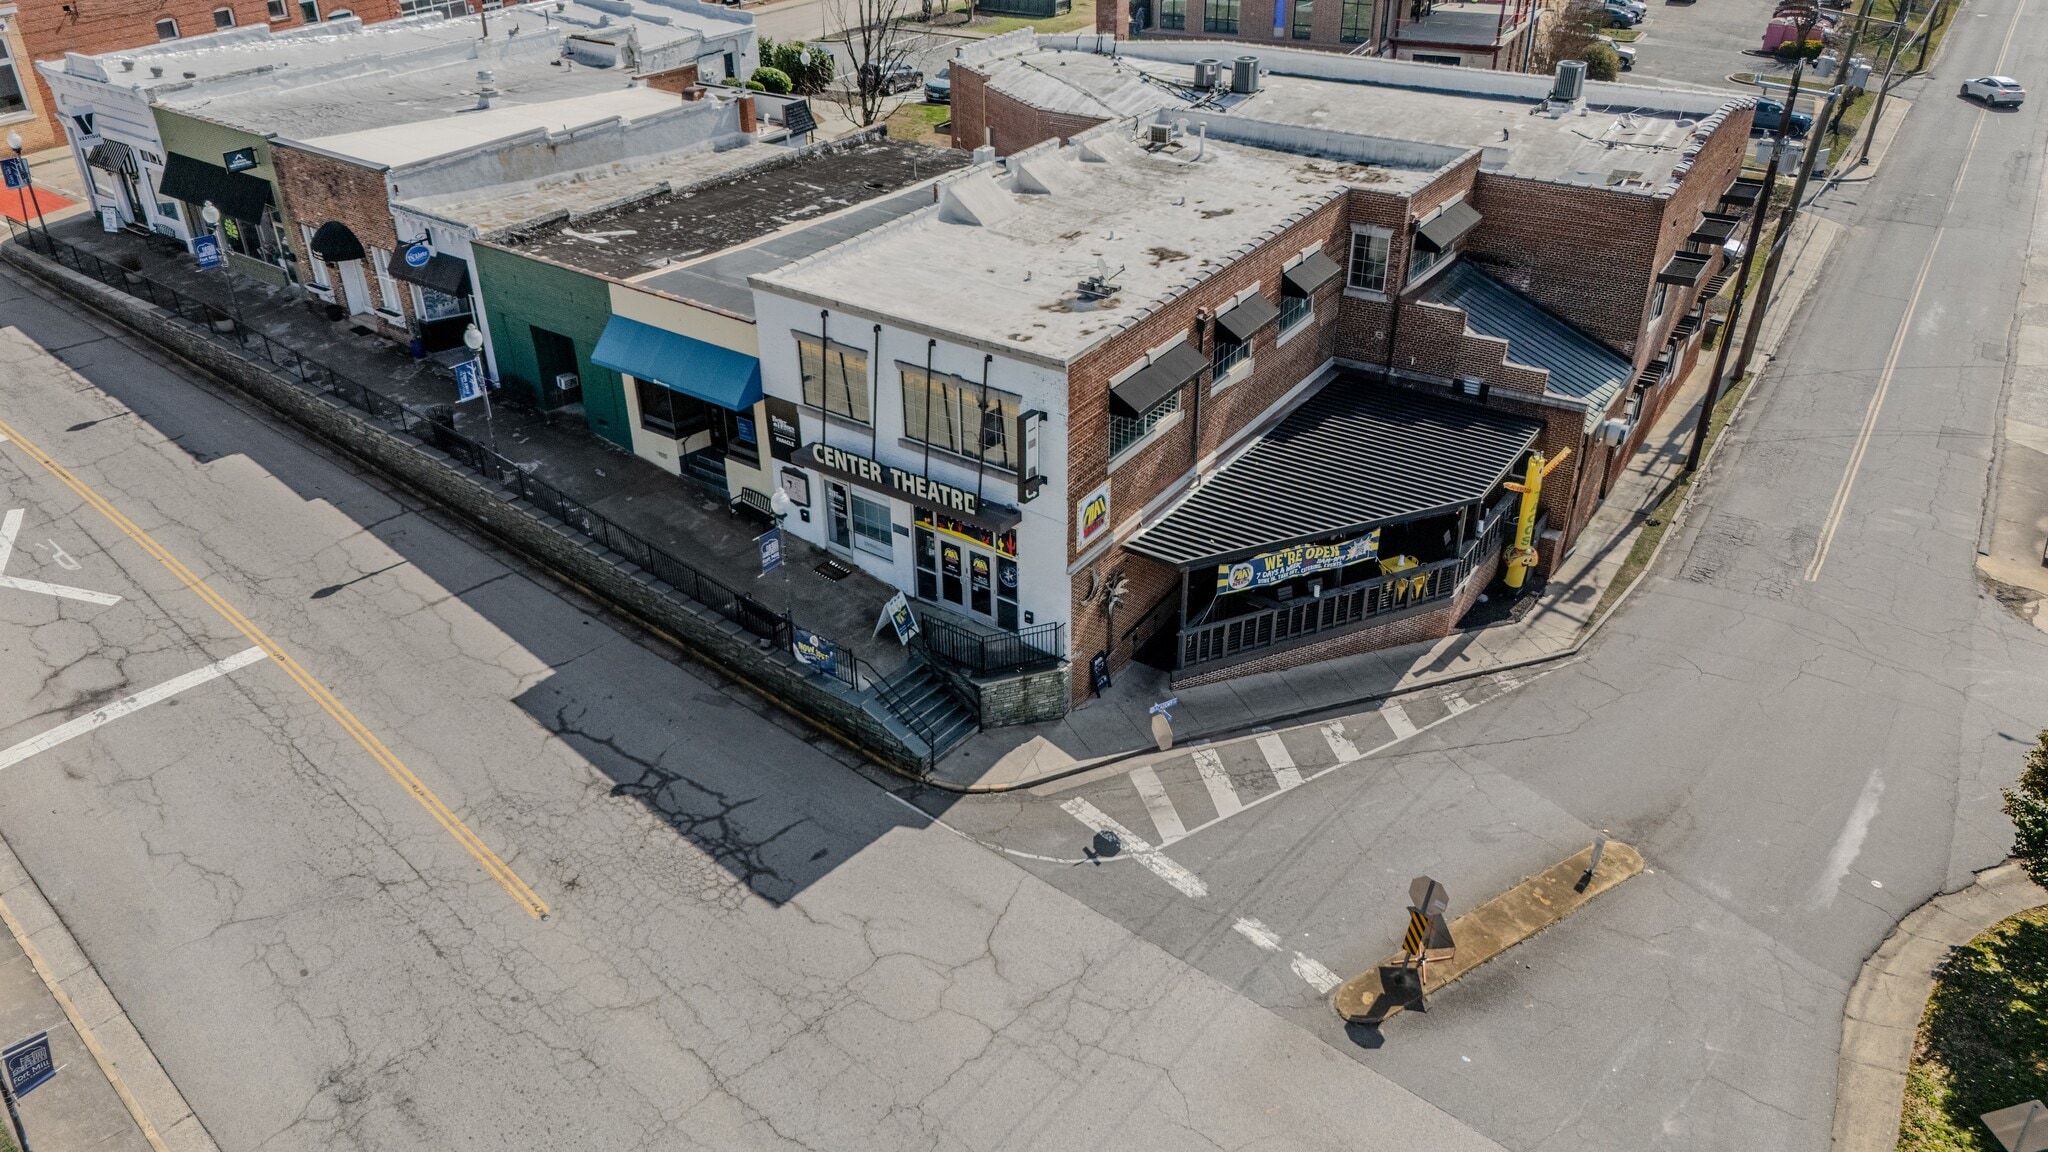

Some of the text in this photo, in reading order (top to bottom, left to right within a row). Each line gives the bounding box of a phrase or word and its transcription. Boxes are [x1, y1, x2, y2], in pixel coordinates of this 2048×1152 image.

[812, 443, 883, 484] CENTER
[1264, 548, 1303, 572] WE'RE
[1305, 545, 1341, 560] OPEN
[1256, 572, 1262, 580] 7
[1262, 569, 1279, 579] DAYS
[1280, 567, 1286, 575] A
[13, 1060, 50, 1085] Fort Mill
